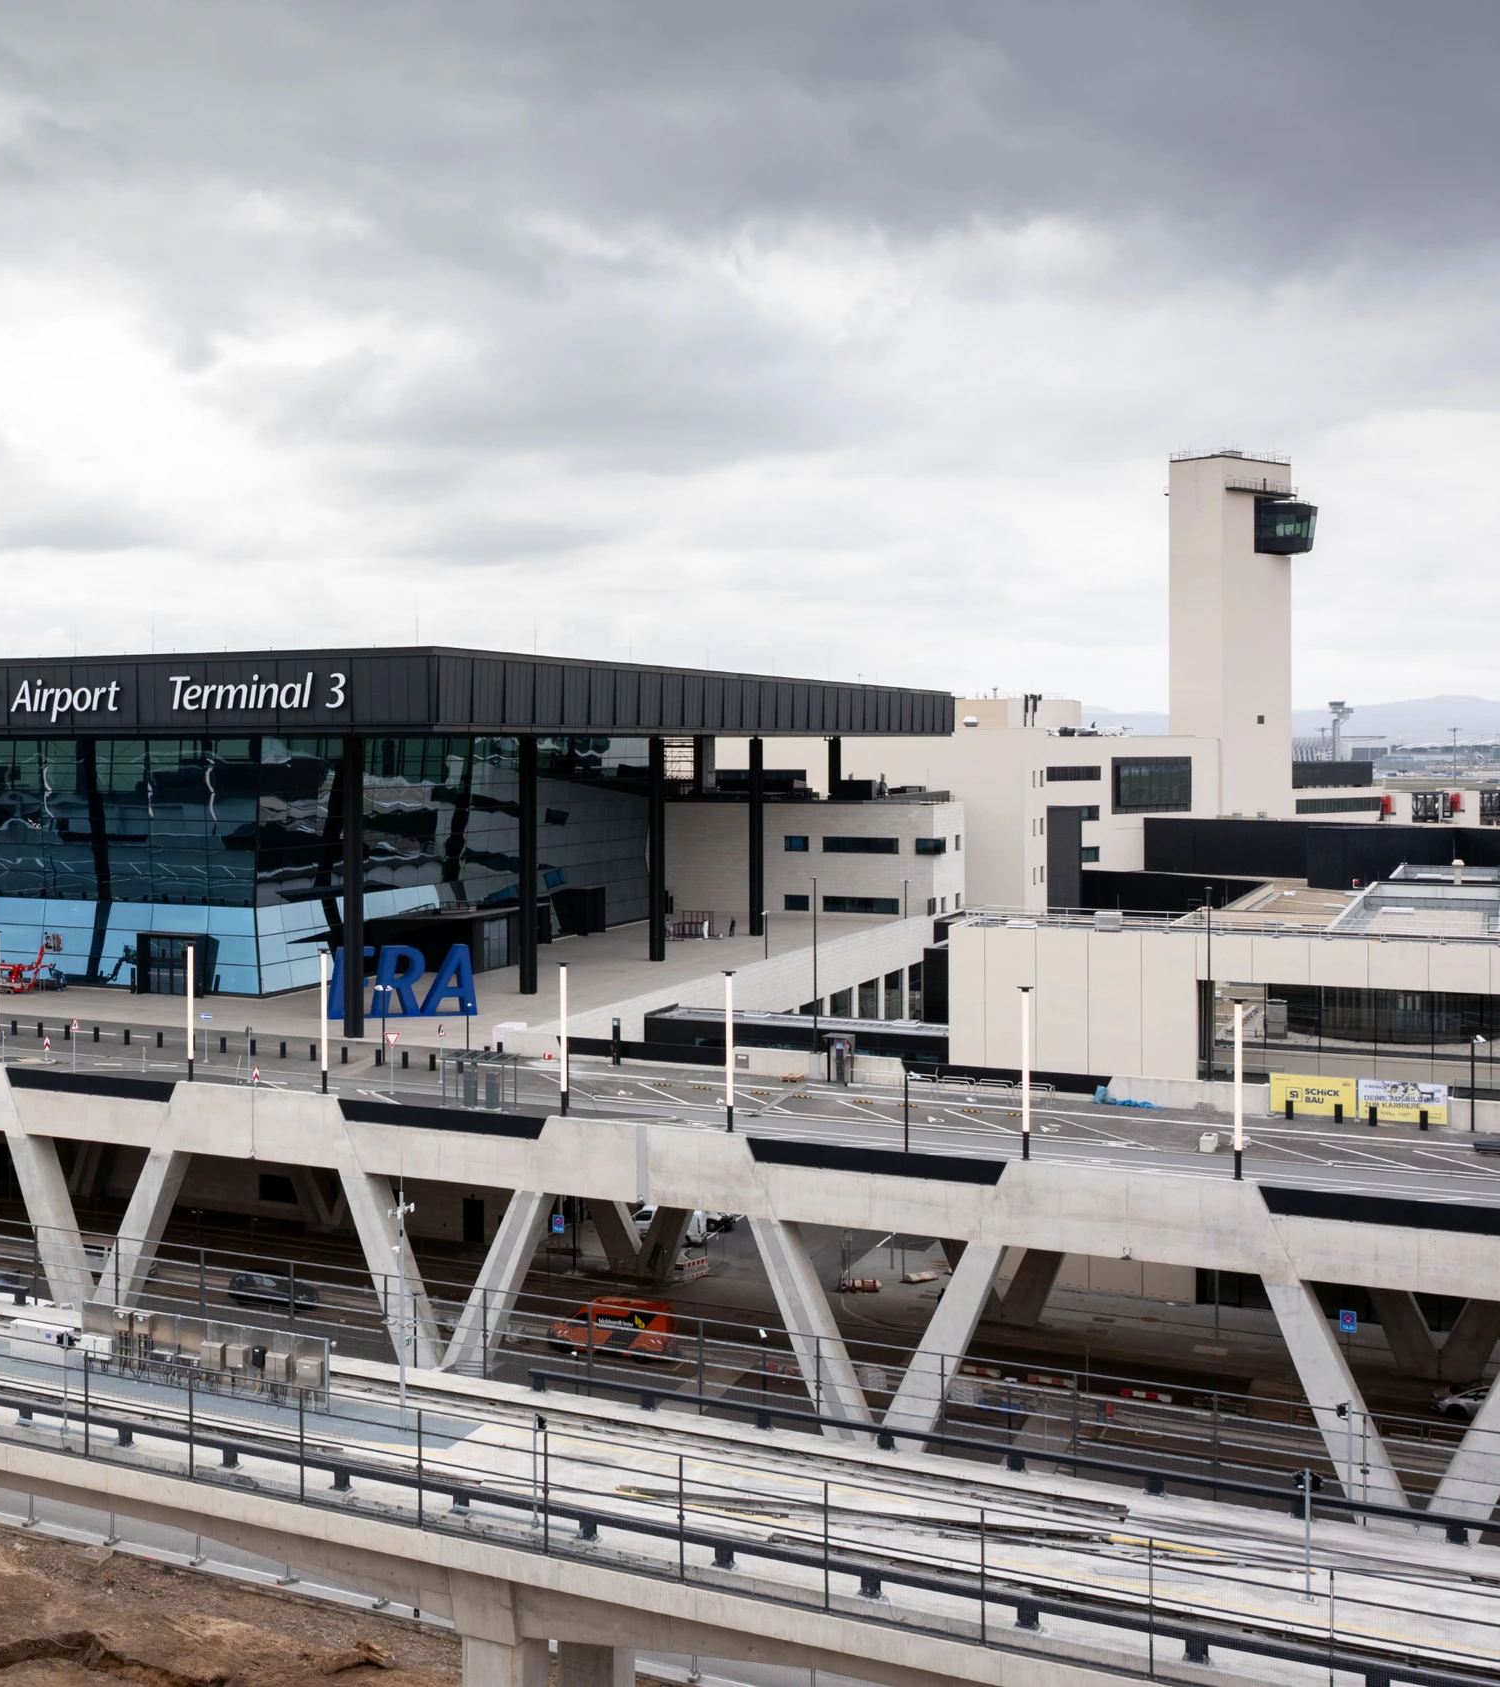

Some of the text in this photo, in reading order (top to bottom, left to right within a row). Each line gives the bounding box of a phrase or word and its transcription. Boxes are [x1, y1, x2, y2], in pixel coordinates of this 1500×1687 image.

[11, 679, 120, 722] Airport
[169, 671, 314, 710] Terminal
[325, 672, 347, 708] 3
[1304, 1096, 1325, 1104] BAU
[1389, 1095, 1441, 1104] AUSBILDUNG
[1364, 1101, 1380, 1109] ZUR
[598, 1317, 622, 1325] bickhardt
